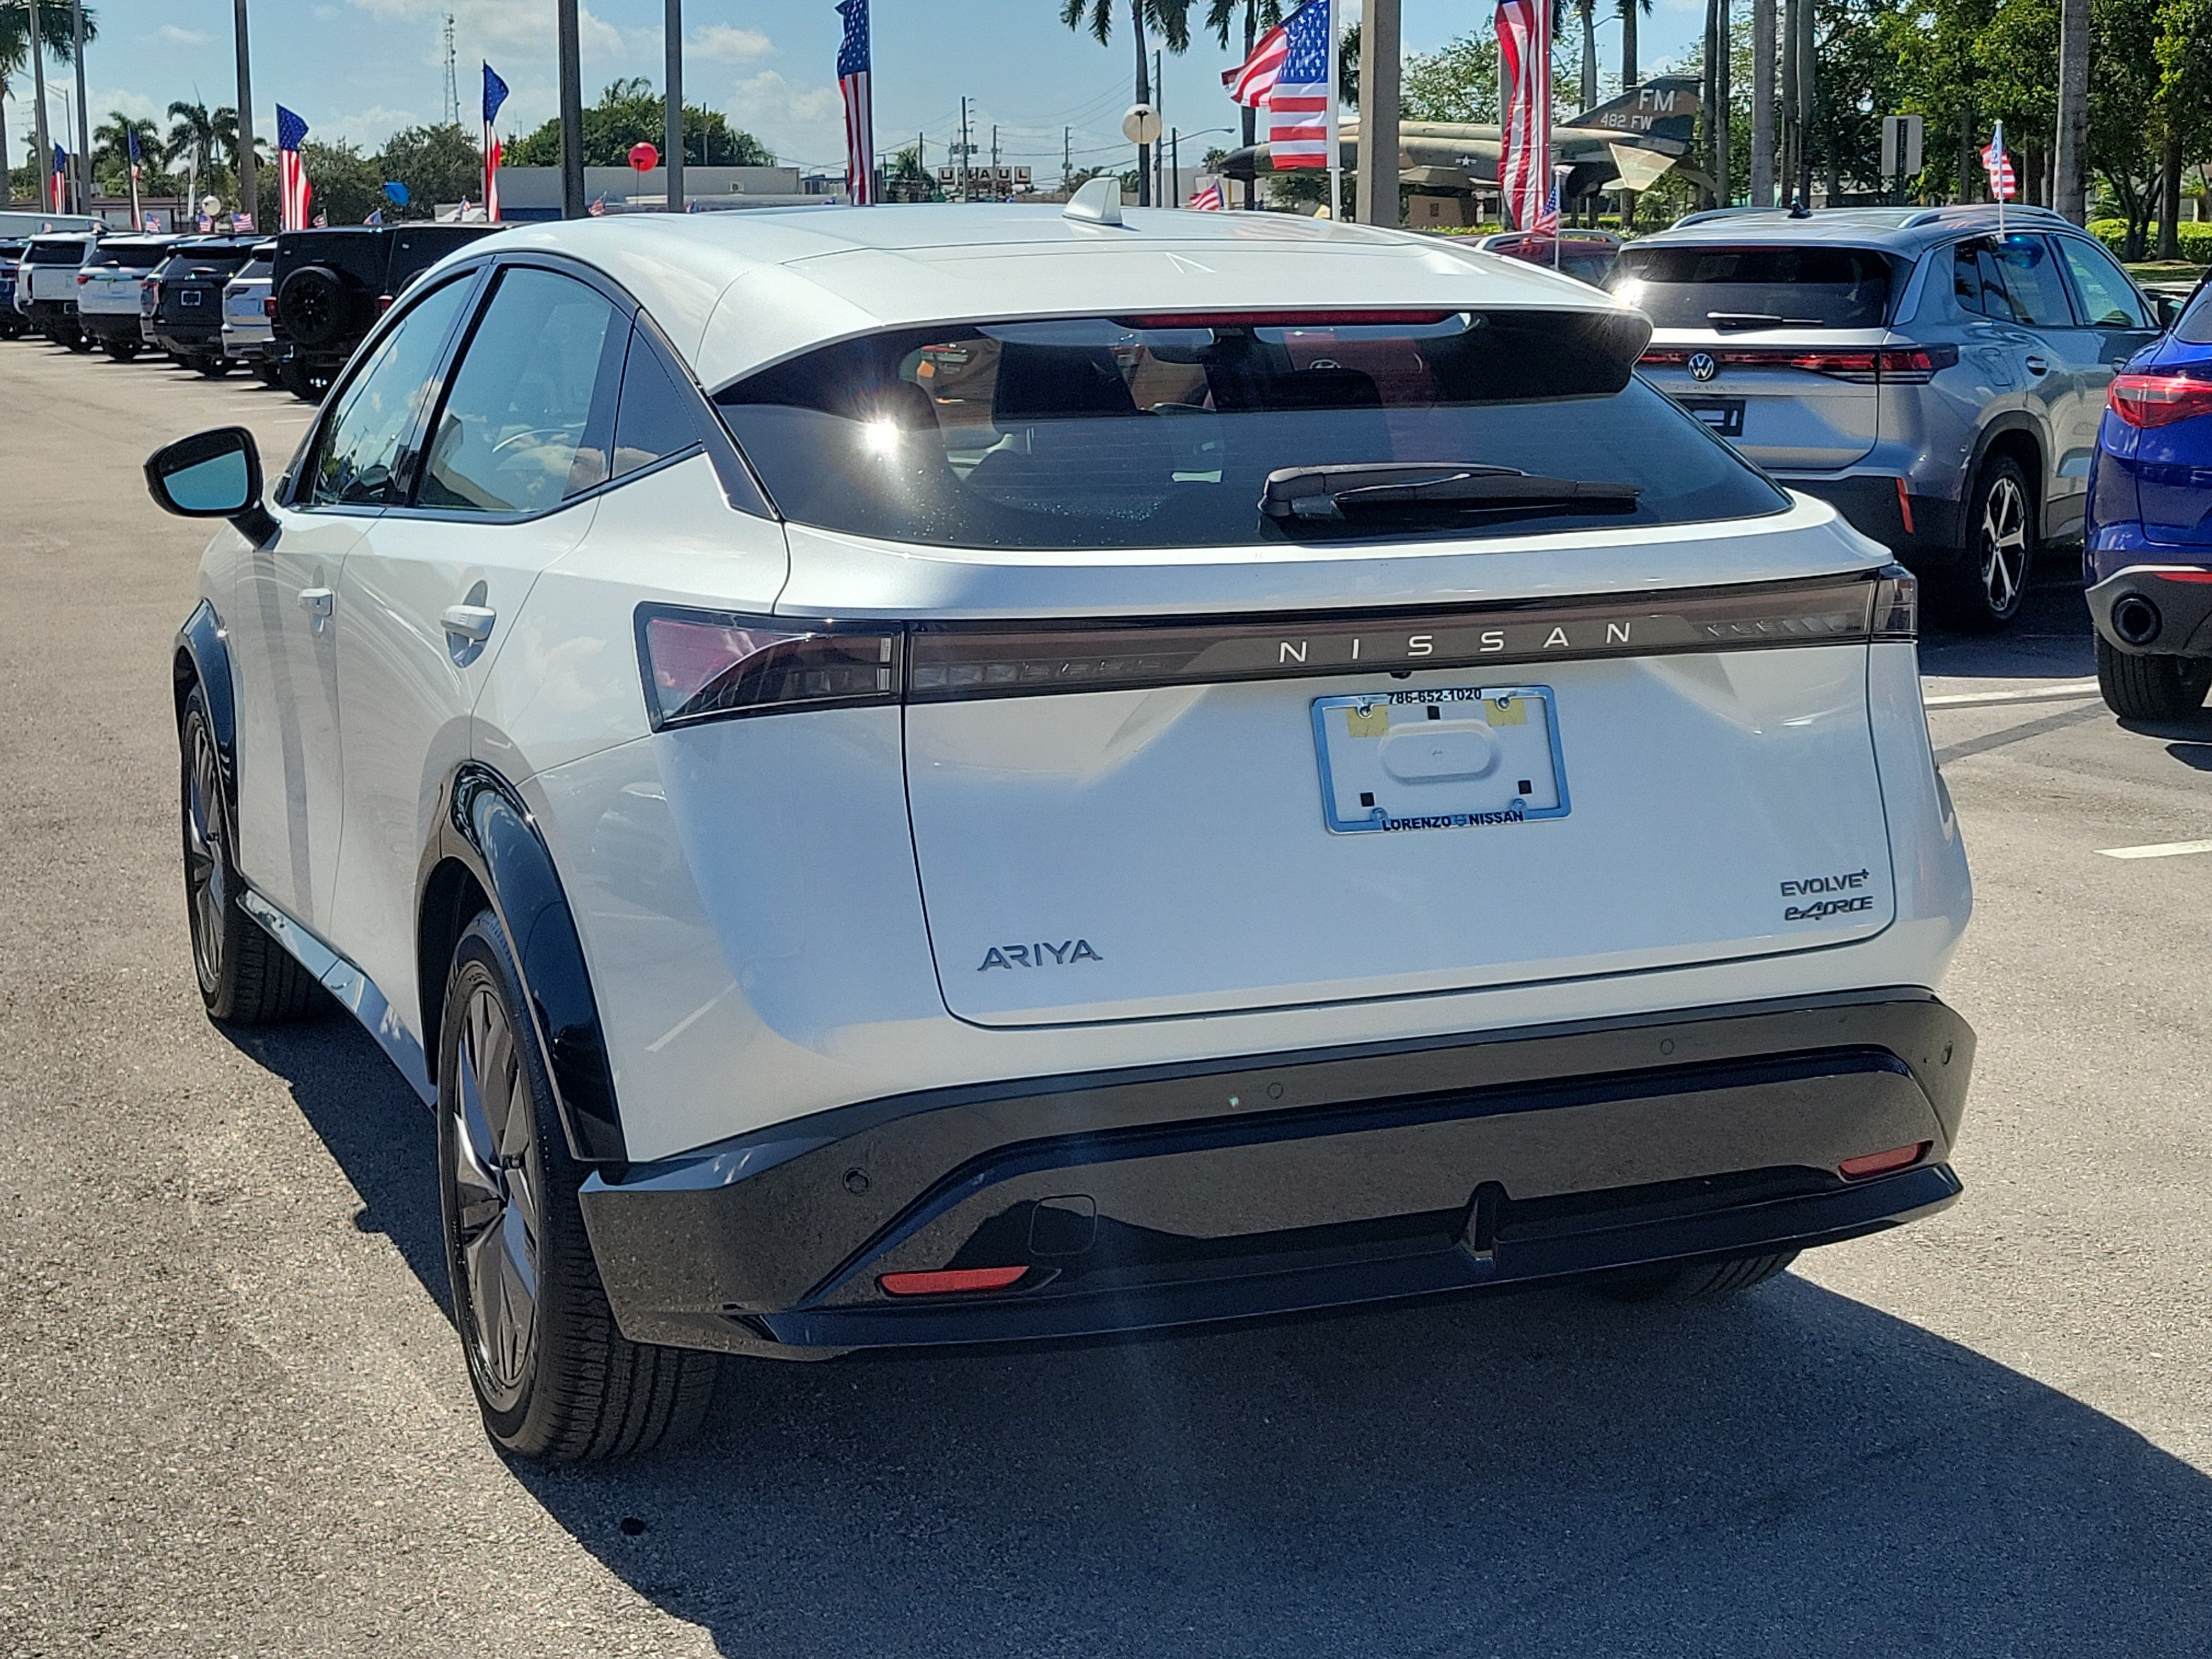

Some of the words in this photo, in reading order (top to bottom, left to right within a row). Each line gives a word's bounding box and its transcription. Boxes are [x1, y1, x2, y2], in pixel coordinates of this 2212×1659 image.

[1638, 88, 1674, 111] FM
[1600, 112, 1626, 128] 482
[1630, 115, 1653, 131] FW
[1279, 622, 1631, 663] NISSAN
[1387, 689, 1482, 705] 786-652-1020
[1381, 816, 1452, 831] LORENZO
[1469, 810, 1524, 826] NISSAN
[977, 939, 1103, 971] ARIYA
